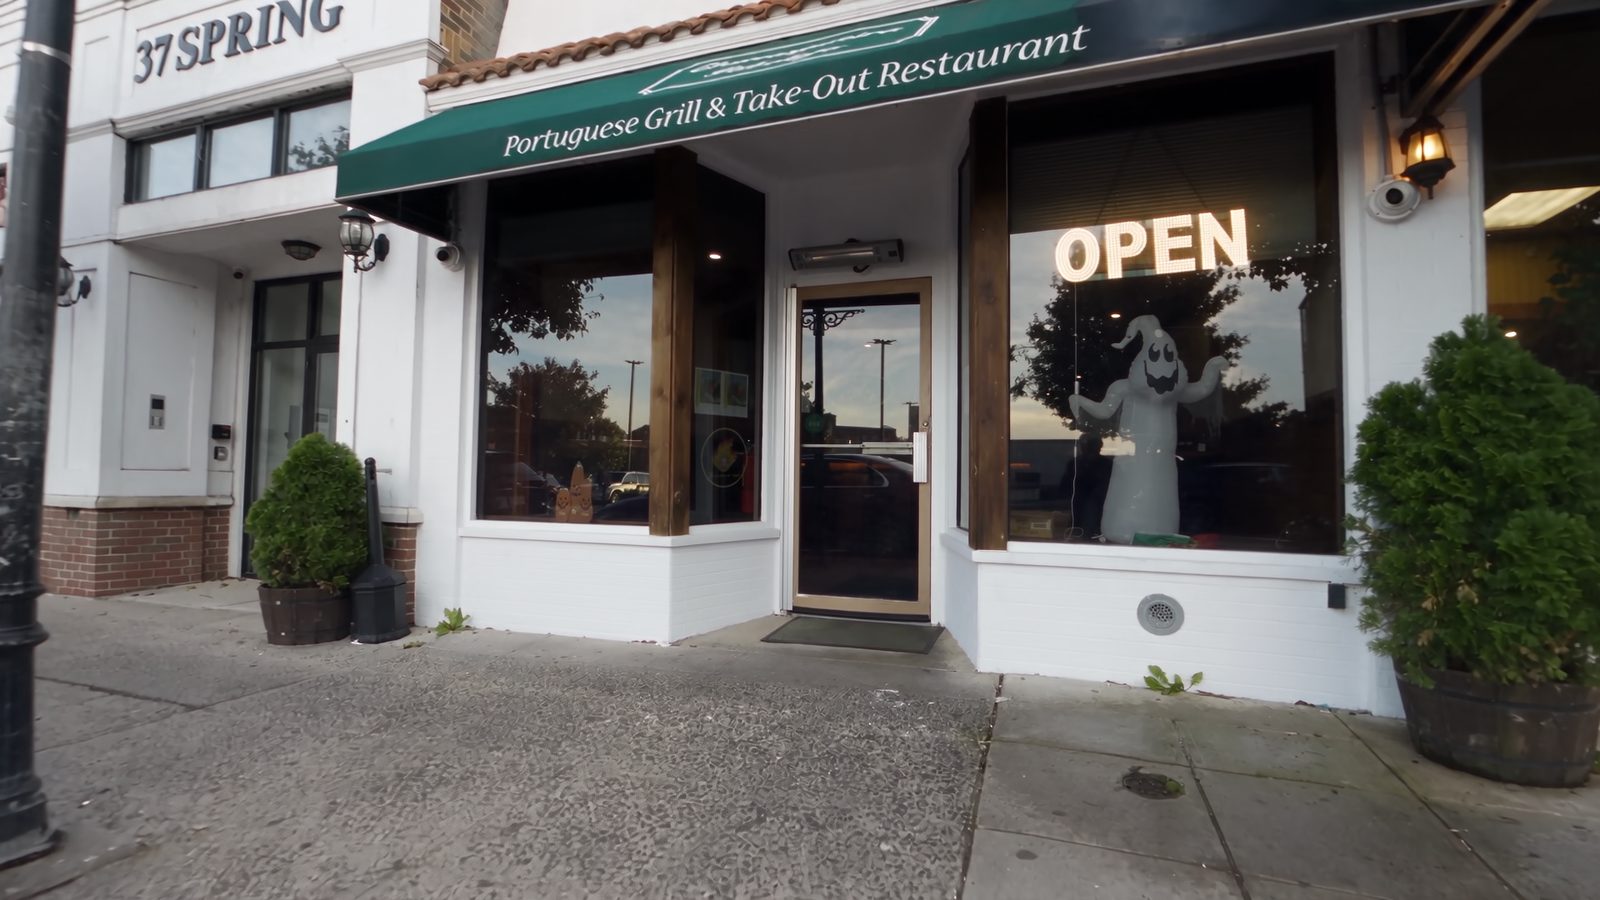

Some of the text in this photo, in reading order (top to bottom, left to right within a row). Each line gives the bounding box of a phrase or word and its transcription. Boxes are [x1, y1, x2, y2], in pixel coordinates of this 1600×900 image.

[503, 116, 639, 157] Portuguese
[644, 98, 702, 130] Grill
[706, 96, 726, 120] &
[732, 68, 873, 116] Take-Out
[876, 24, 1091, 88] Restaurant
[1055, 208, 1248, 282] OPEN
